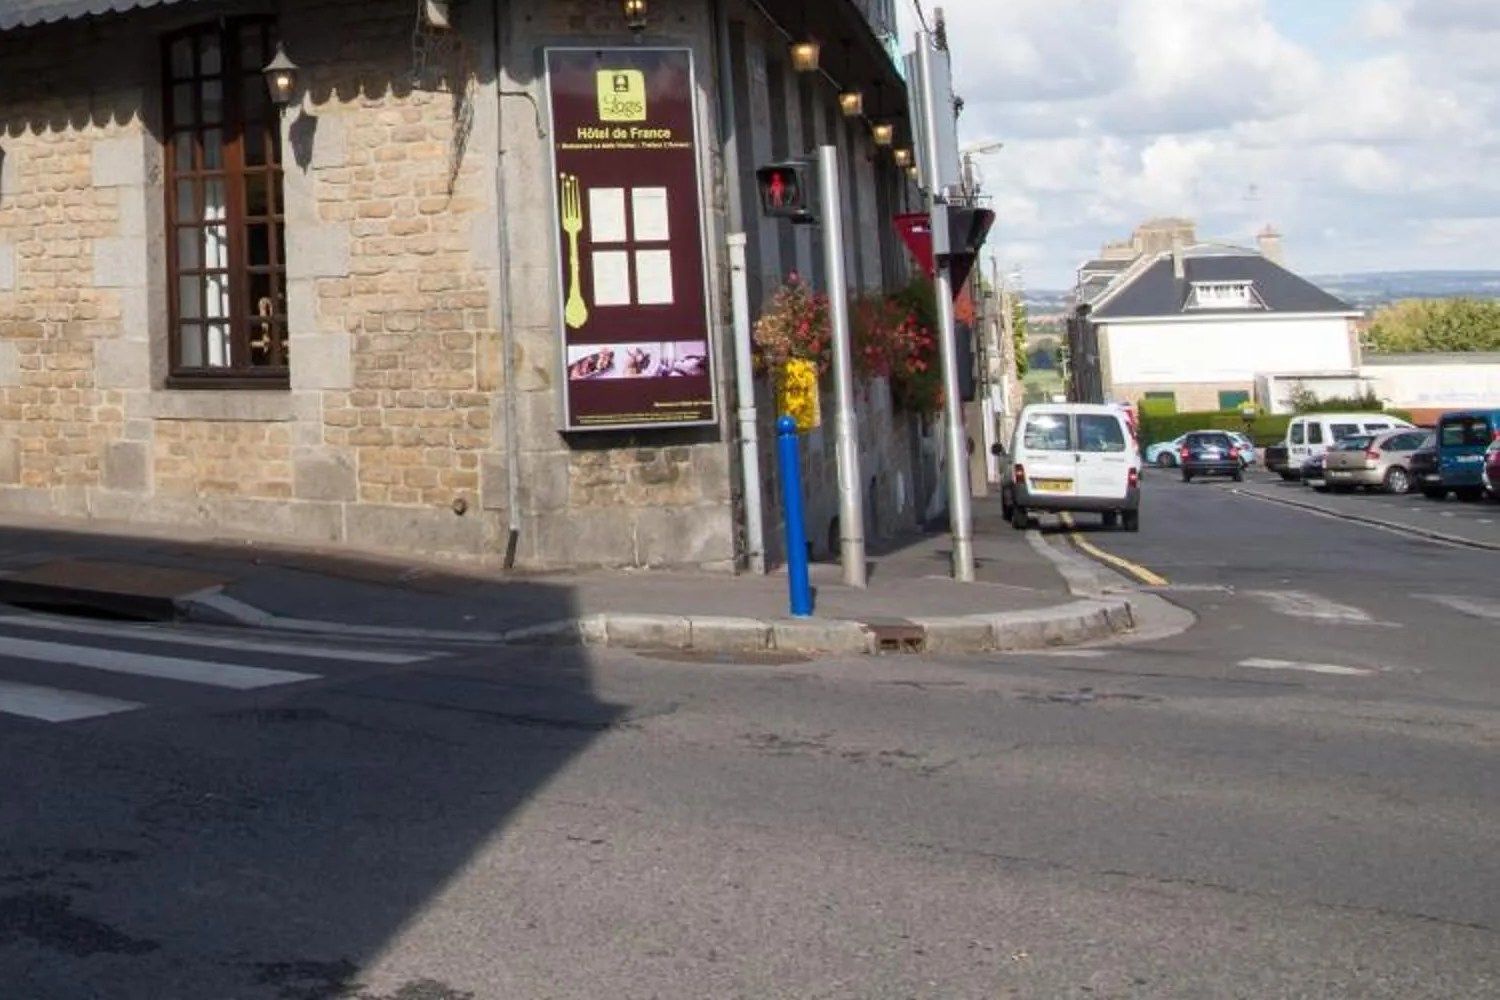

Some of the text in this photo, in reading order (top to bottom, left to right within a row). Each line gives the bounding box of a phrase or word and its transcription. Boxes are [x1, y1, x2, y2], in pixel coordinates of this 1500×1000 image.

[577, 127, 671, 139] Hôtel de France
